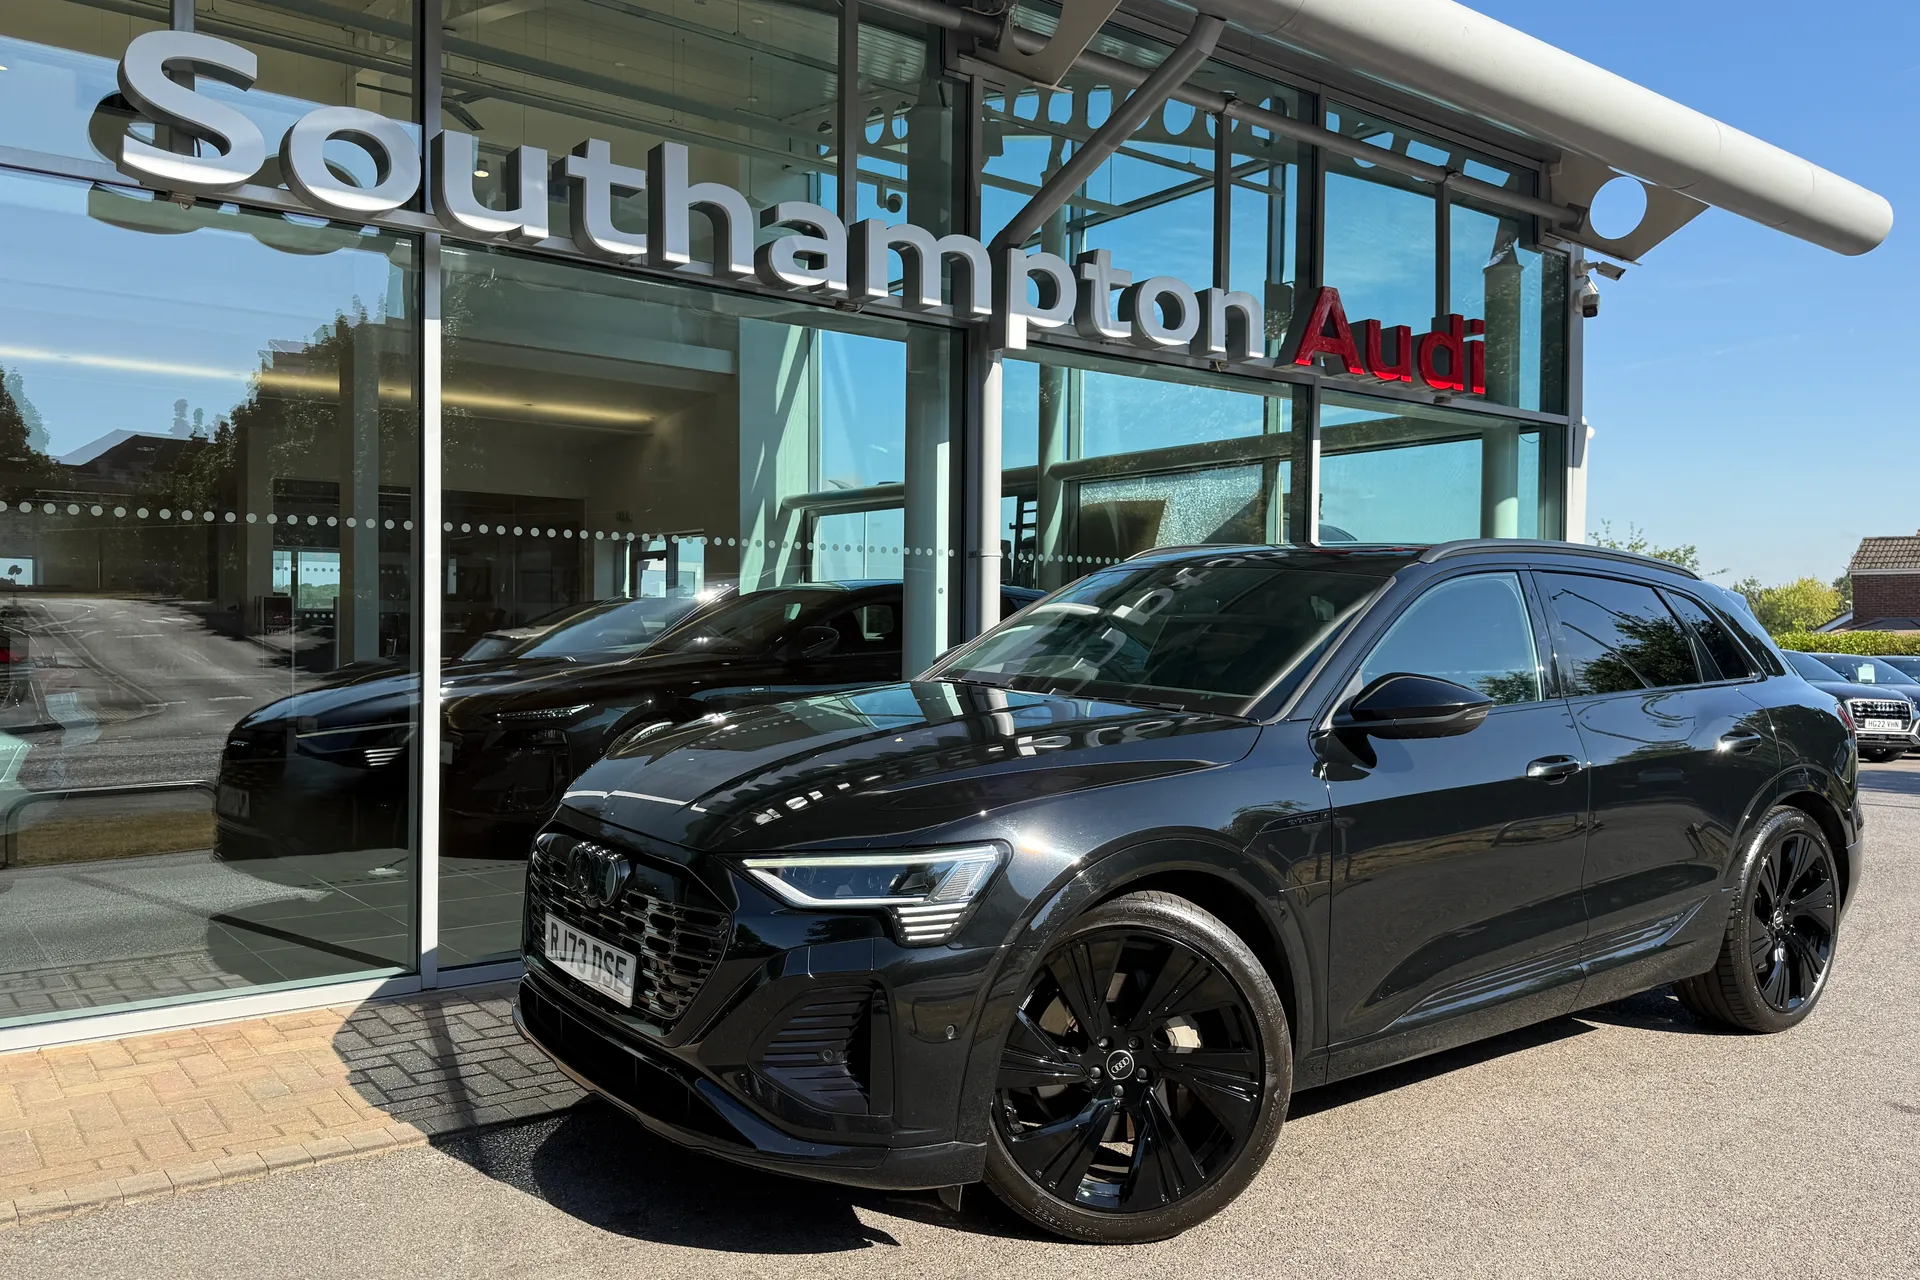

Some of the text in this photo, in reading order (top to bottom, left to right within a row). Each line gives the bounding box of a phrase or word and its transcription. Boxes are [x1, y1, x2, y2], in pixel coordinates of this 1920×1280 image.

[117, 29, 1486, 395] Southampton Audi
[550, 921, 587, 975] RJ73
[591, 944, 627, 996] DSE
